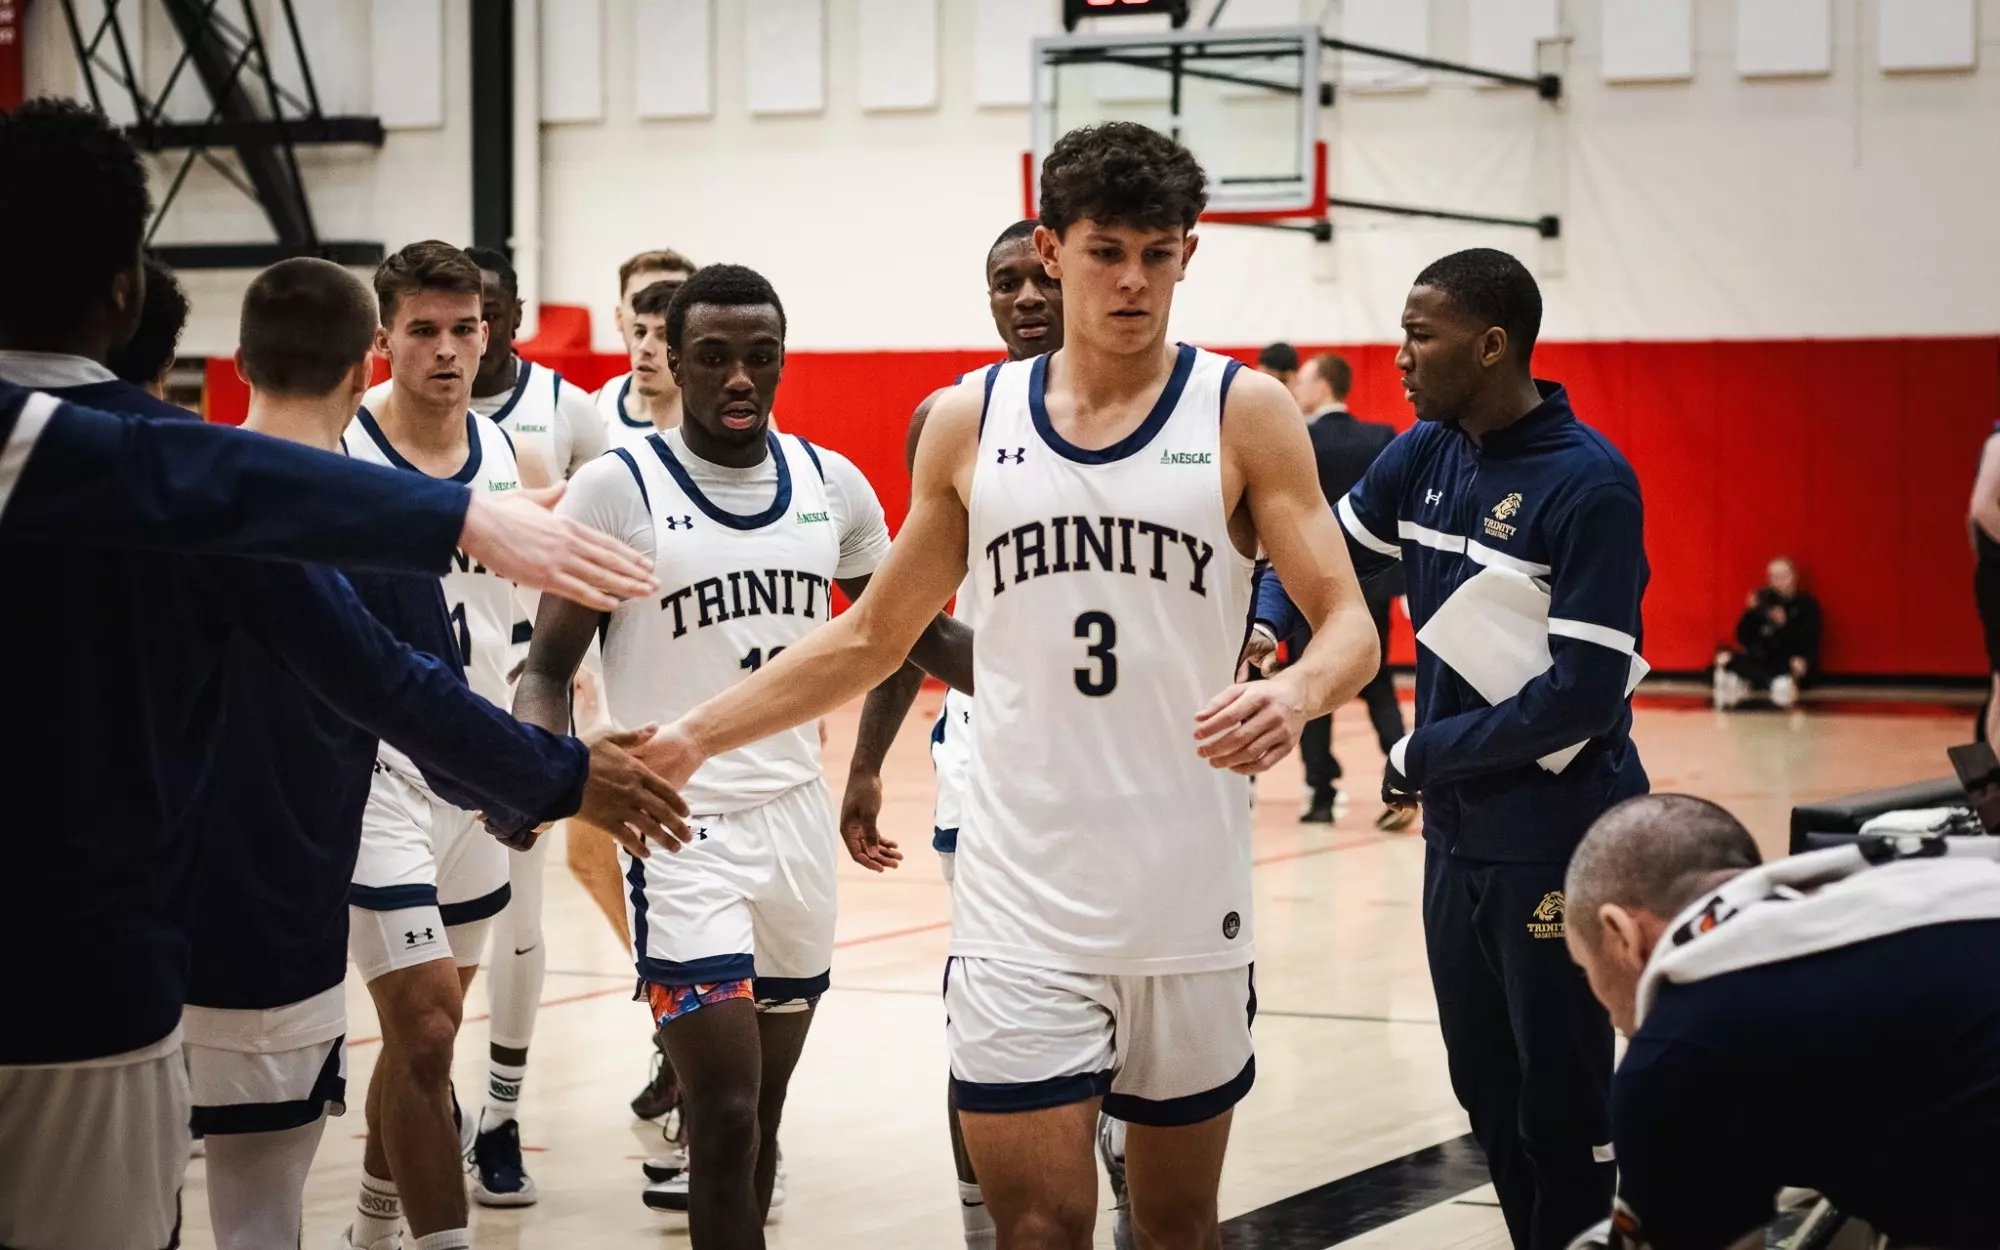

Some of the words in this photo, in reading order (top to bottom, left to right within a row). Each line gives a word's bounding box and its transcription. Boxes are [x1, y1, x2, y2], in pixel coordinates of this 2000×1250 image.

[1170, 452, 1212, 464] NESCAC
[1484, 517, 1517, 536] TRINITY
[983, 516, 1213, 598] TRINITY
[1073, 610, 1118, 697] 3
[1527, 923, 1565, 933] TRINIT
